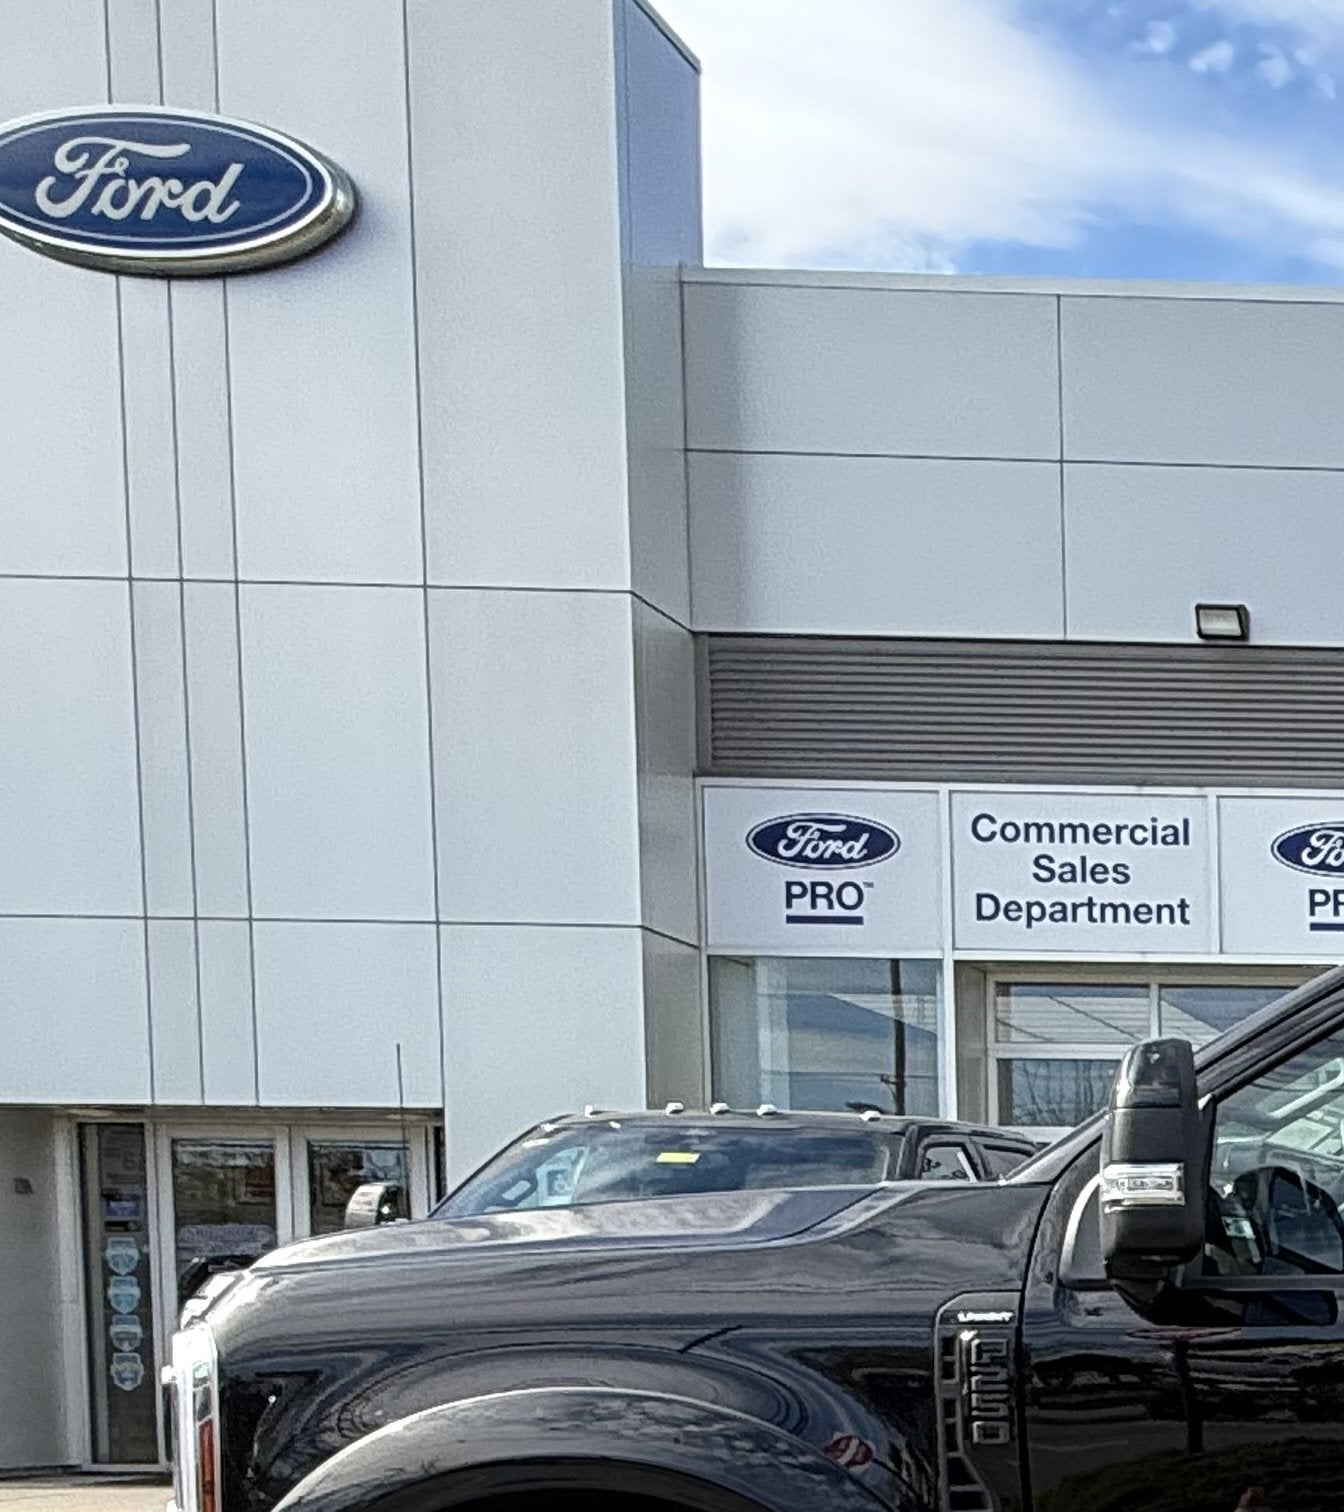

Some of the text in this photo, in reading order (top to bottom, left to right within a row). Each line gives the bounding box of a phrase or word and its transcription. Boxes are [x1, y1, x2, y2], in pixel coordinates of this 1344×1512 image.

[35, 136, 245, 224] Ford
[777, 821, 870, 860] Ford
[971, 813, 1190, 846] Commercial
[1032, 853, 1131, 885] Sales
[975, 892, 1191, 929] Department
